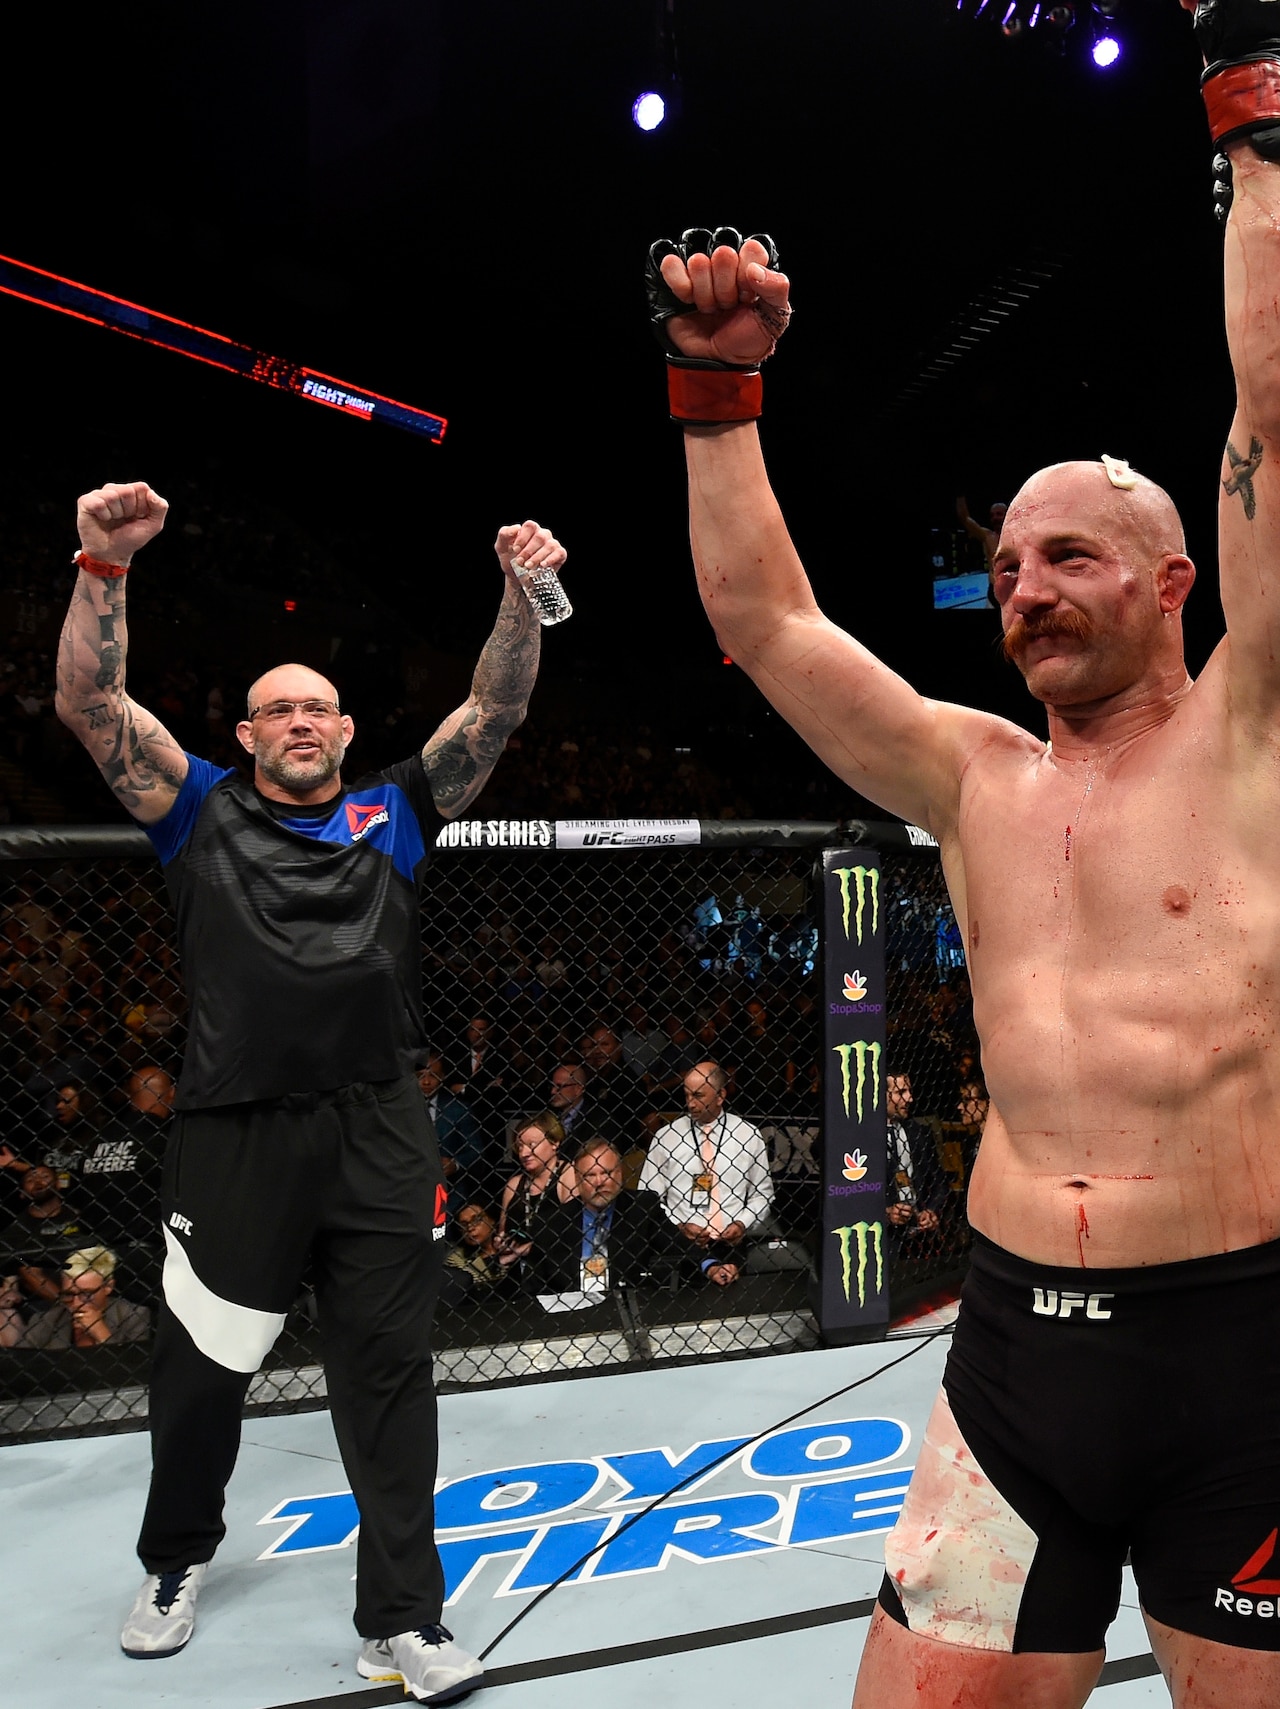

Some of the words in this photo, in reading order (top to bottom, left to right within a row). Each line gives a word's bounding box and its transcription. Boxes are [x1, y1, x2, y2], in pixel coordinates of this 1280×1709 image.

[302, 380, 347, 405] FIGHT
[345, 395, 375, 413] NIGHT
[436, 820, 482, 848] NDER
[486, 819, 552, 847] SERIES
[582, 831, 624, 846] UFC
[646, 833, 676, 845] PASS
[829, 1001, 882, 1017] Stop&Shop
[828, 1181, 883, 1198] Stop&Shop
[169, 1211, 194, 1237] UFC
[1032, 1287, 1115, 1320] UFC
[256, 1416, 911, 1560] TOYO
